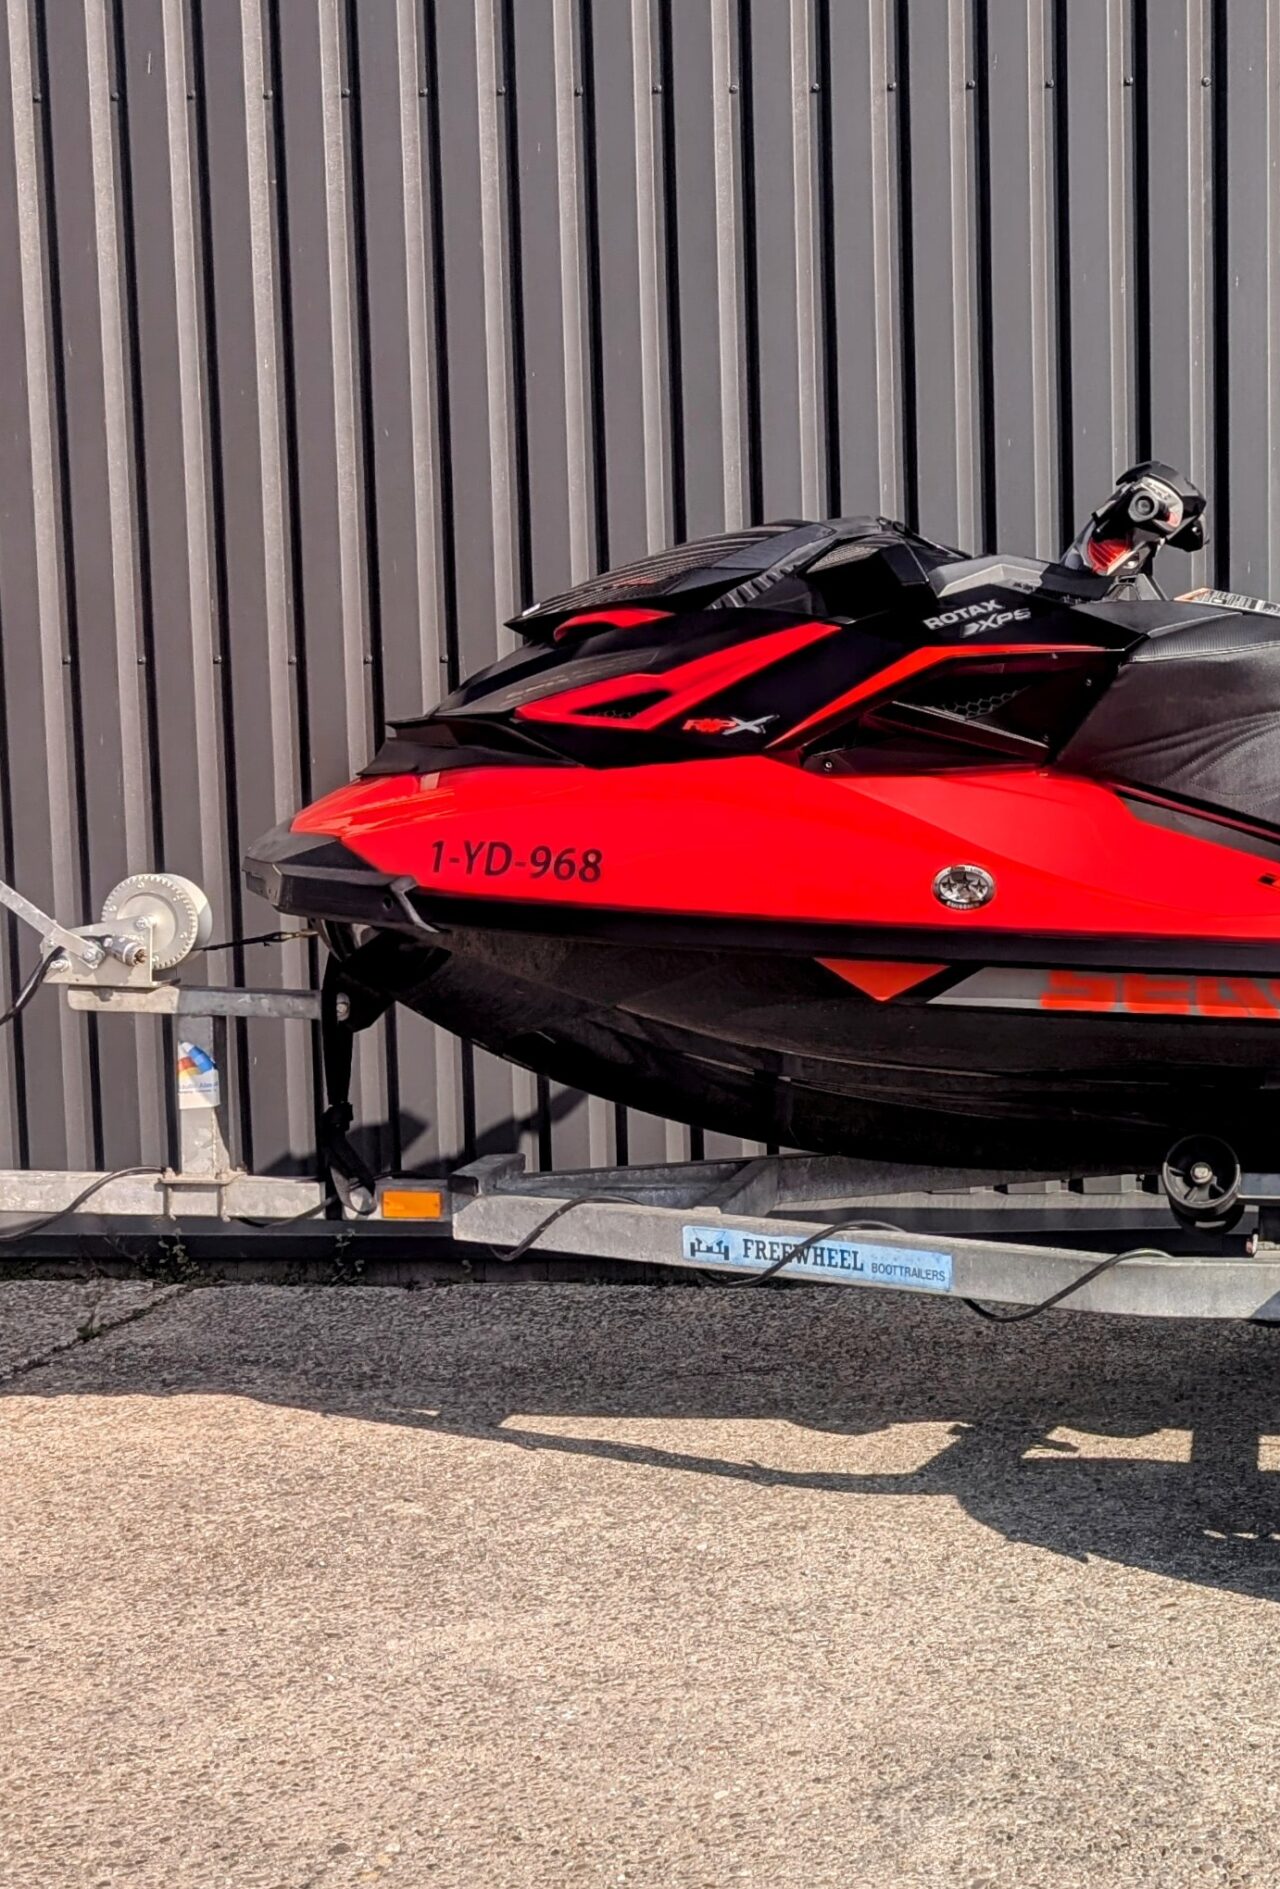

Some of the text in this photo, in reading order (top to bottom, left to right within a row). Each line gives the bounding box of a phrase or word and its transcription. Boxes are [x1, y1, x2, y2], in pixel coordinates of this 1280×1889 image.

[923, 599, 1005, 630] ROTAX
[978, 608, 1031, 632] XPS
[432, 840, 602, 884] 1-YD-968
[742, 1238, 946, 1281] FREEWHEEL BOOTTRAILERS
